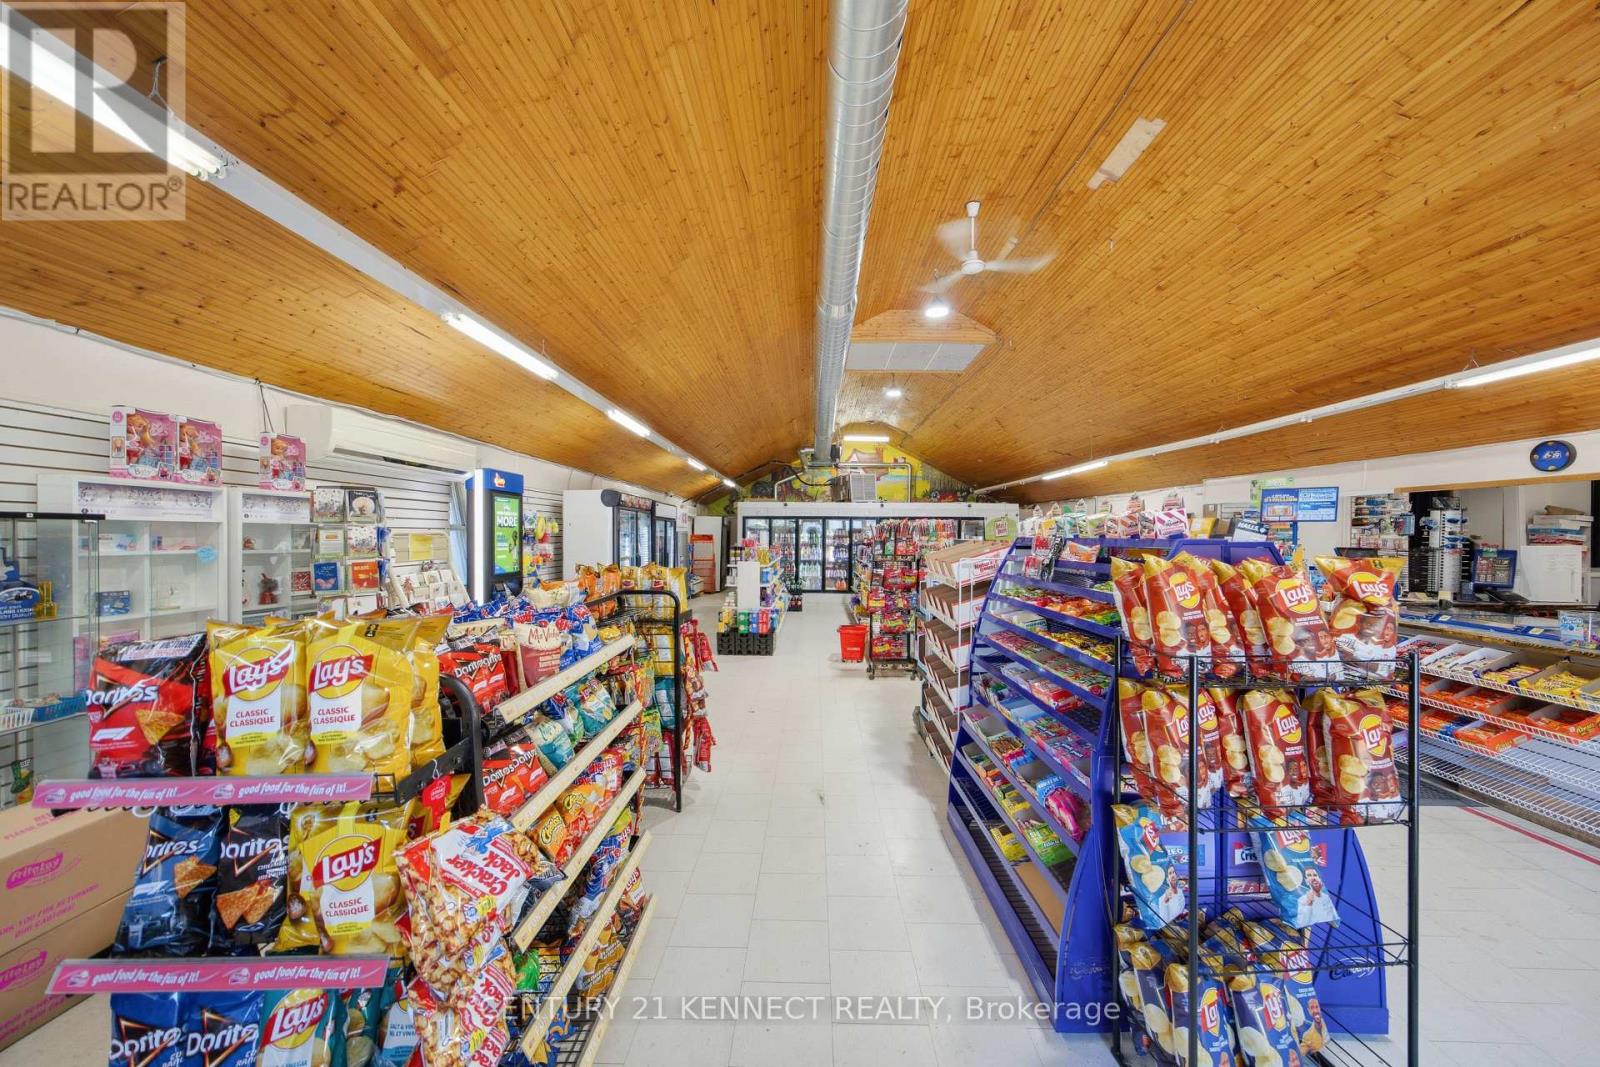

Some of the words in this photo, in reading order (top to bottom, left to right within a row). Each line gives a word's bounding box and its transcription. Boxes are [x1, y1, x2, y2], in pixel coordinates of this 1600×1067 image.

[496, 515, 518, 527] MORE
[1280, 583, 1313, 607] Lay's
[1353, 580, 1389, 598] Lay's
[229, 657, 289, 694] Lay's
[314, 656, 365, 690] Lay's
[236, 708, 269, 718] CLASSIC
[313, 714, 356, 725] CLASSIQUE
[318, 706, 350, 716] CLASSIC
[230, 716, 275, 727] CLASSIQUE
[482, 763, 513, 784] Doritos
[70, 788, 91, 803] good
[92, 787, 111, 800] food
[112, 786, 125, 799] for
[126, 789, 138, 798] the
[138, 789, 155, 801] fun
[155, 789, 165, 801] of
[165, 787, 177, 798] it!
[238, 784, 260, 798] good
[260, 783, 281, 795] food
[281, 782, 294, 795] for
[295, 783, 309, 793] the
[309, 785, 325, 797] fun
[325, 784, 335, 797] of
[335, 783, 347, 794] it!
[322, 843, 375, 883] Lay's
[483, 851, 521, 881] Jack
[446, 854, 508, 896] Cracker
[325, 905, 369, 917] CLASSIQUE
[329, 897, 362, 909] CLASSIC
[91, 971, 115, 986] good
[115, 970, 134, 983] food
[134, 969, 149, 982] for
[149, 971, 162, 983] the
[161, 972, 177, 985] fun
[178, 972, 187, 985] of
[188, 971, 200, 982] it!
[254, 969, 276, 983] good
[276, 966, 297, 980] food
[297, 966, 310, 980] for
[310, 967, 324, 978] the
[324, 968, 339, 982] fun
[339, 968, 349, 982] of
[350, 967, 361, 979] it!
[271, 996, 325, 1042] Lay's
[110, 1026, 183, 1060] Dorito
[186, 1023, 260, 1057] Dorito
